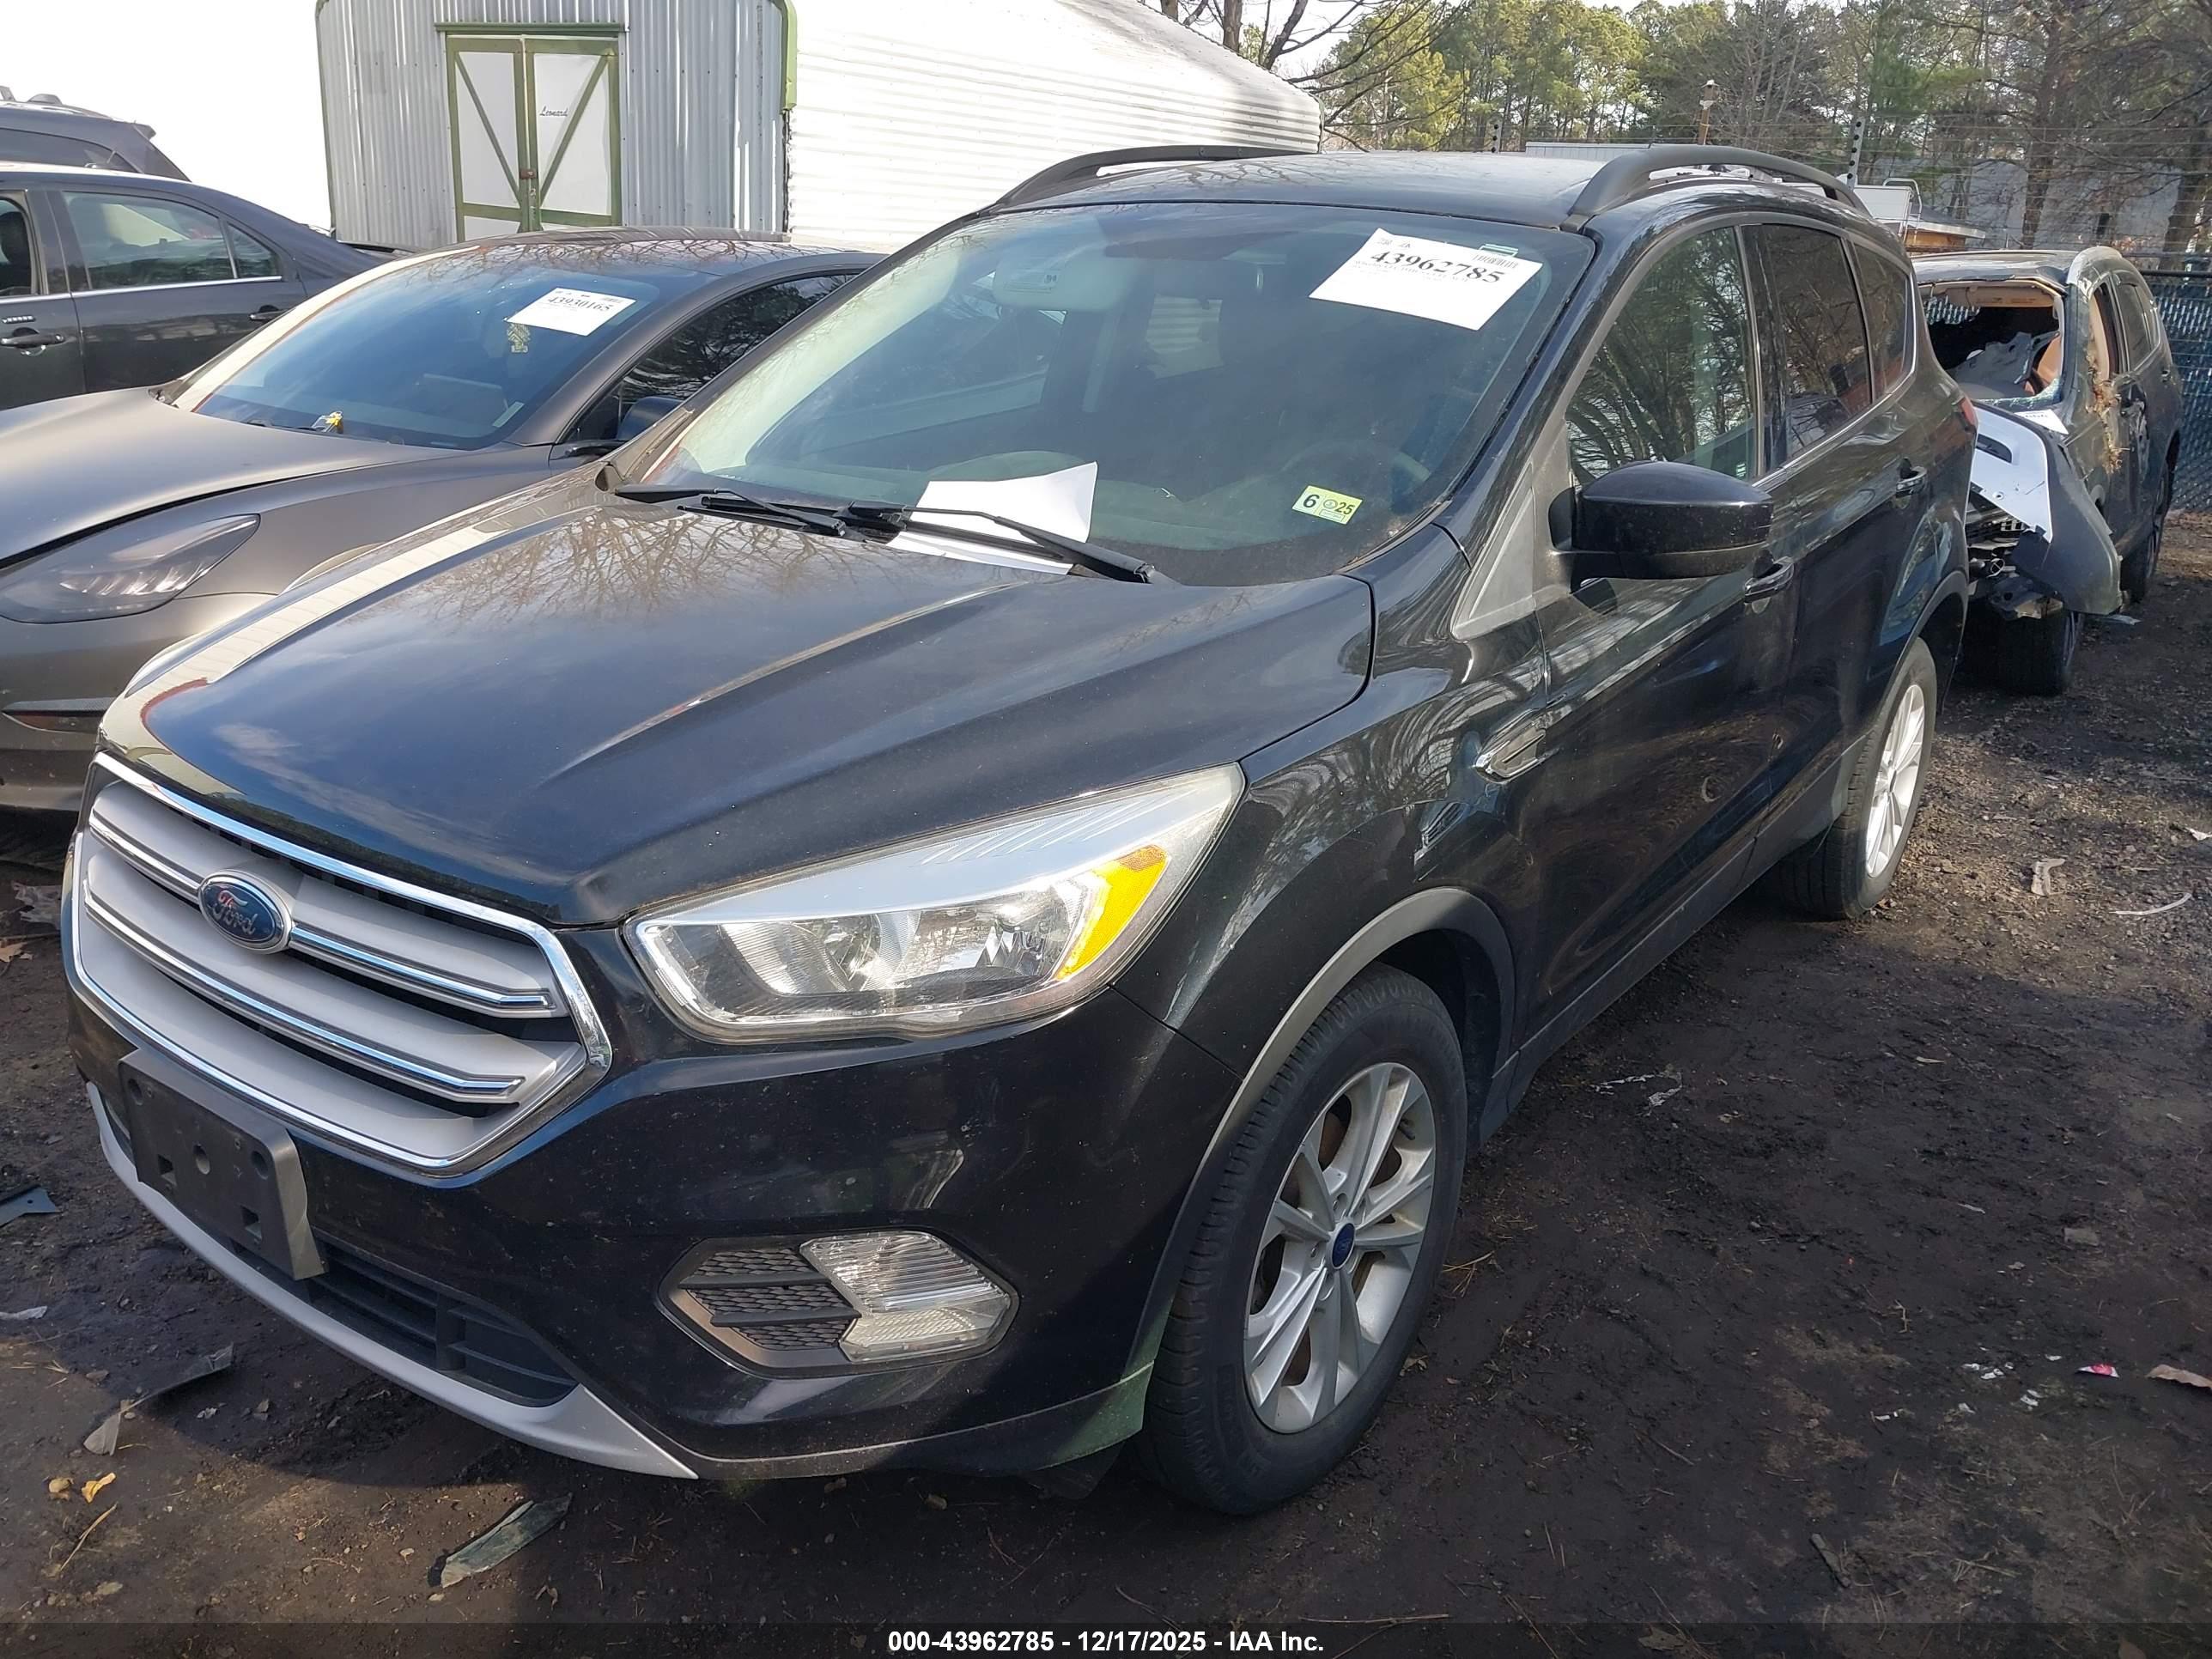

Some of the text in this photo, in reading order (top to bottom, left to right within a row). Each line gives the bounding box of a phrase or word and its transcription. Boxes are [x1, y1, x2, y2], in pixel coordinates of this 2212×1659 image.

[1370, 250, 1504, 283] 43962785
[1303, 494, 1320, 508] 6
[1334, 501, 1356, 515] 25
[206, 889, 258, 936] Ford
